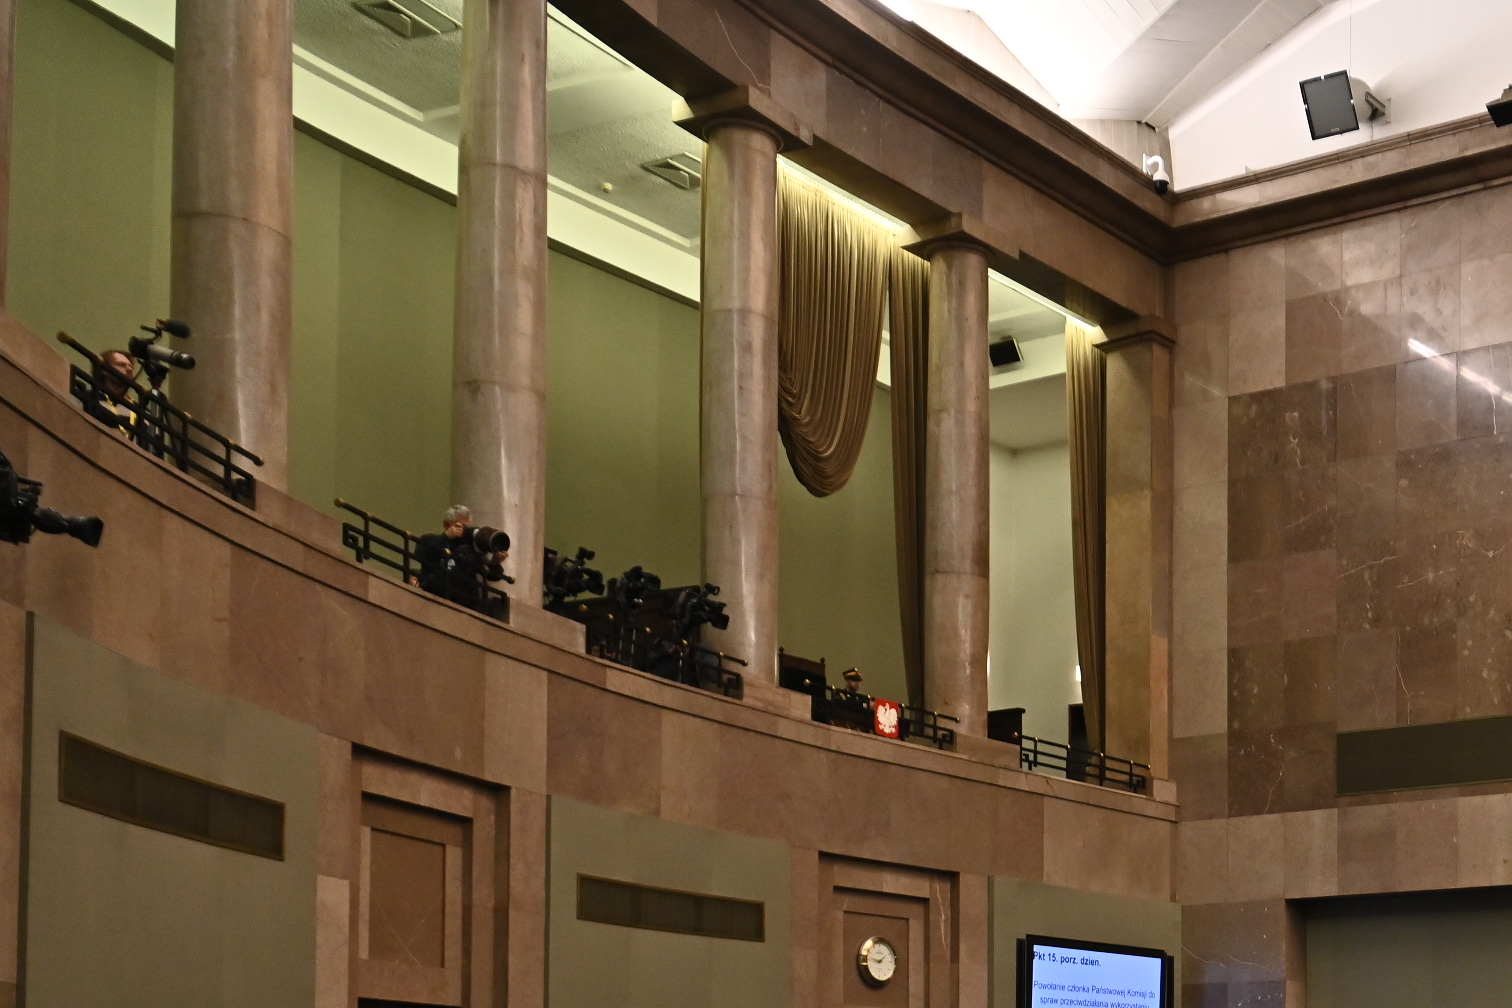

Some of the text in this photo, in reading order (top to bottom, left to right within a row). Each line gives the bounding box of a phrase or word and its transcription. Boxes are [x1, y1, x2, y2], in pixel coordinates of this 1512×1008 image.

[1034, 951, 1101, 966] Pkt 15. porz. dzien.
[1034, 980, 1155, 999] Powołanie członka Państwowej Komisji do
[1060, 998, 1108, 1008] przeciwdziałania
